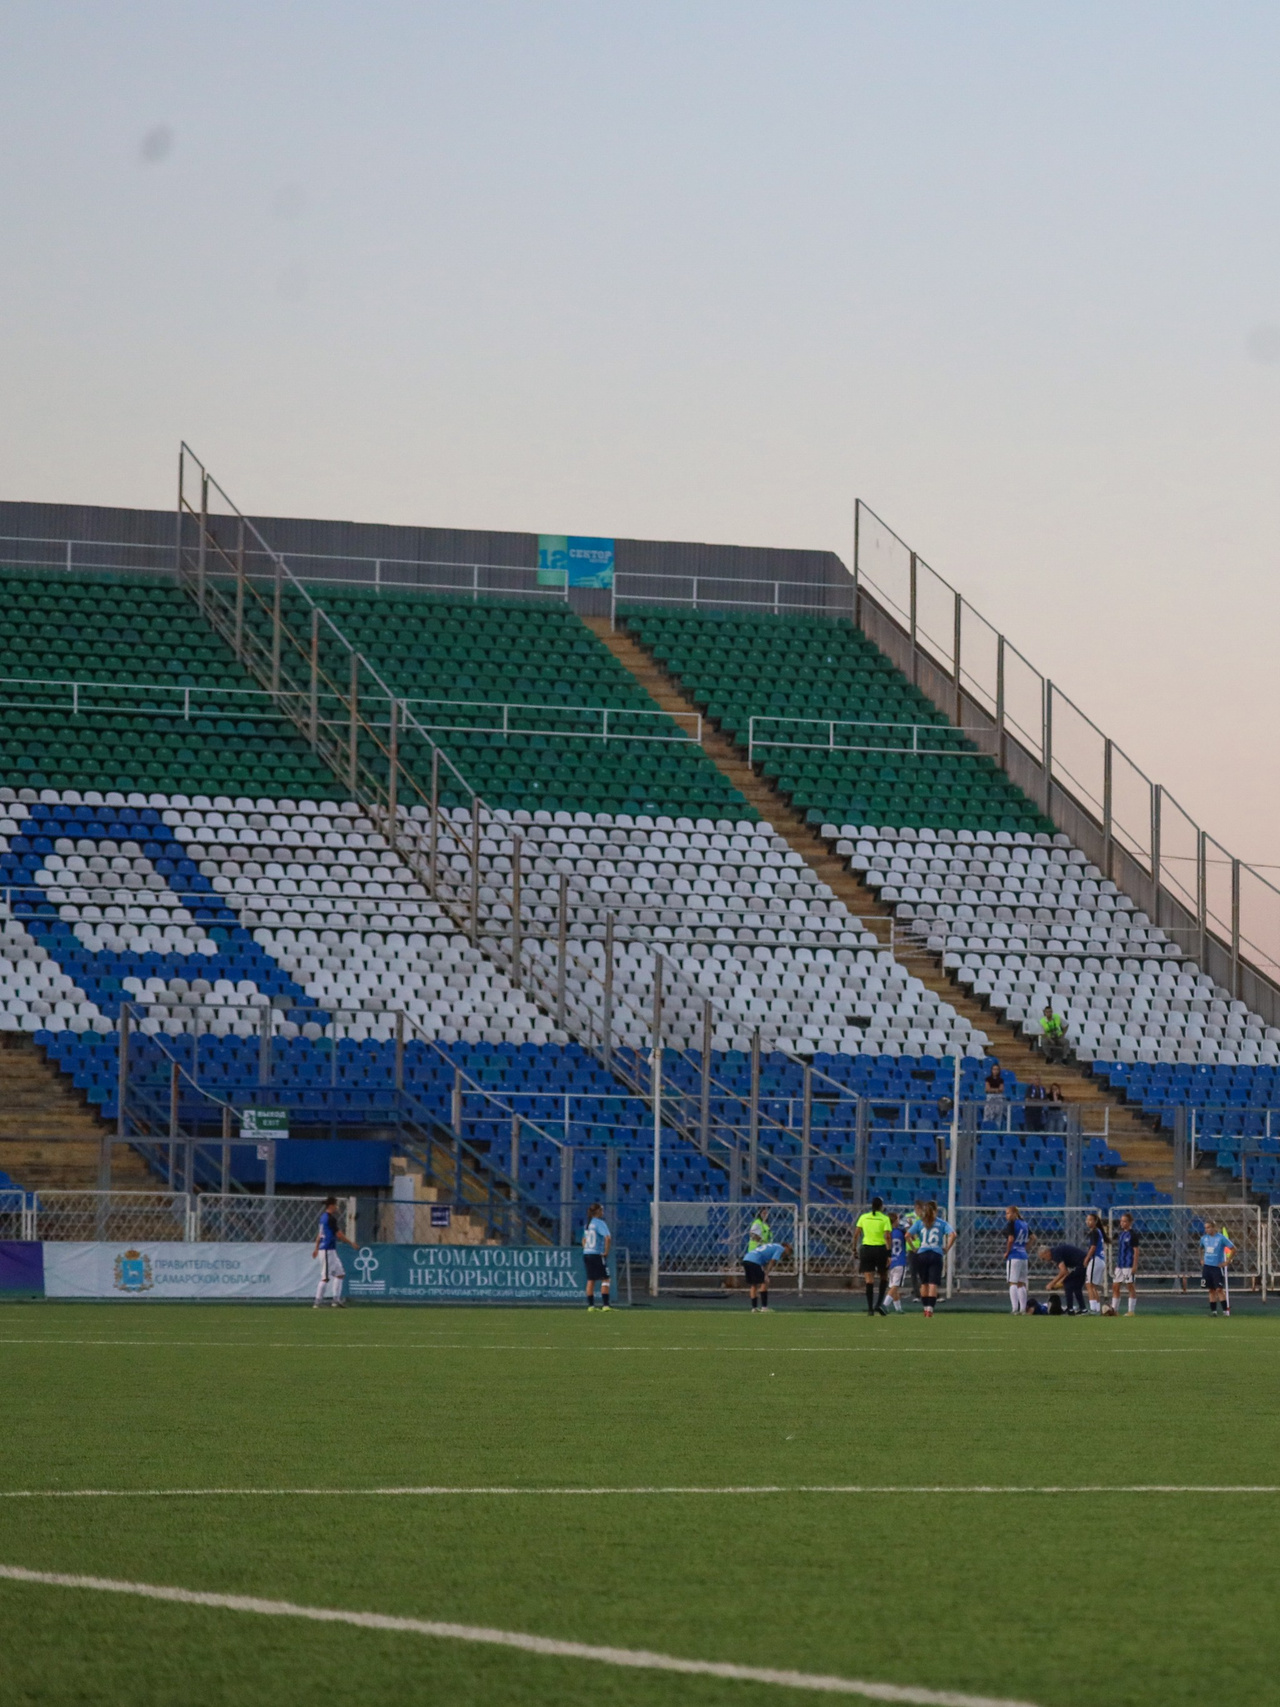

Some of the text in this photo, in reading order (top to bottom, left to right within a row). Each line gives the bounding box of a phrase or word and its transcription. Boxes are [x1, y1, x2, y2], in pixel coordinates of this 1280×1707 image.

[569, 549, 612, 560] СЕКТОР
[921, 1227, 940, 1248] 16
[154, 1260, 240, 1270] ПРАВИТЕЛЬСТВО
[413, 1248, 572, 1268] СТОМАТОЛОГИЯ
[154, 1273, 271, 1284] САМАРСКОЙ ОБЛАСТИ
[409, 1268, 579, 1288] НЕКОРЫСНОВЫХ
